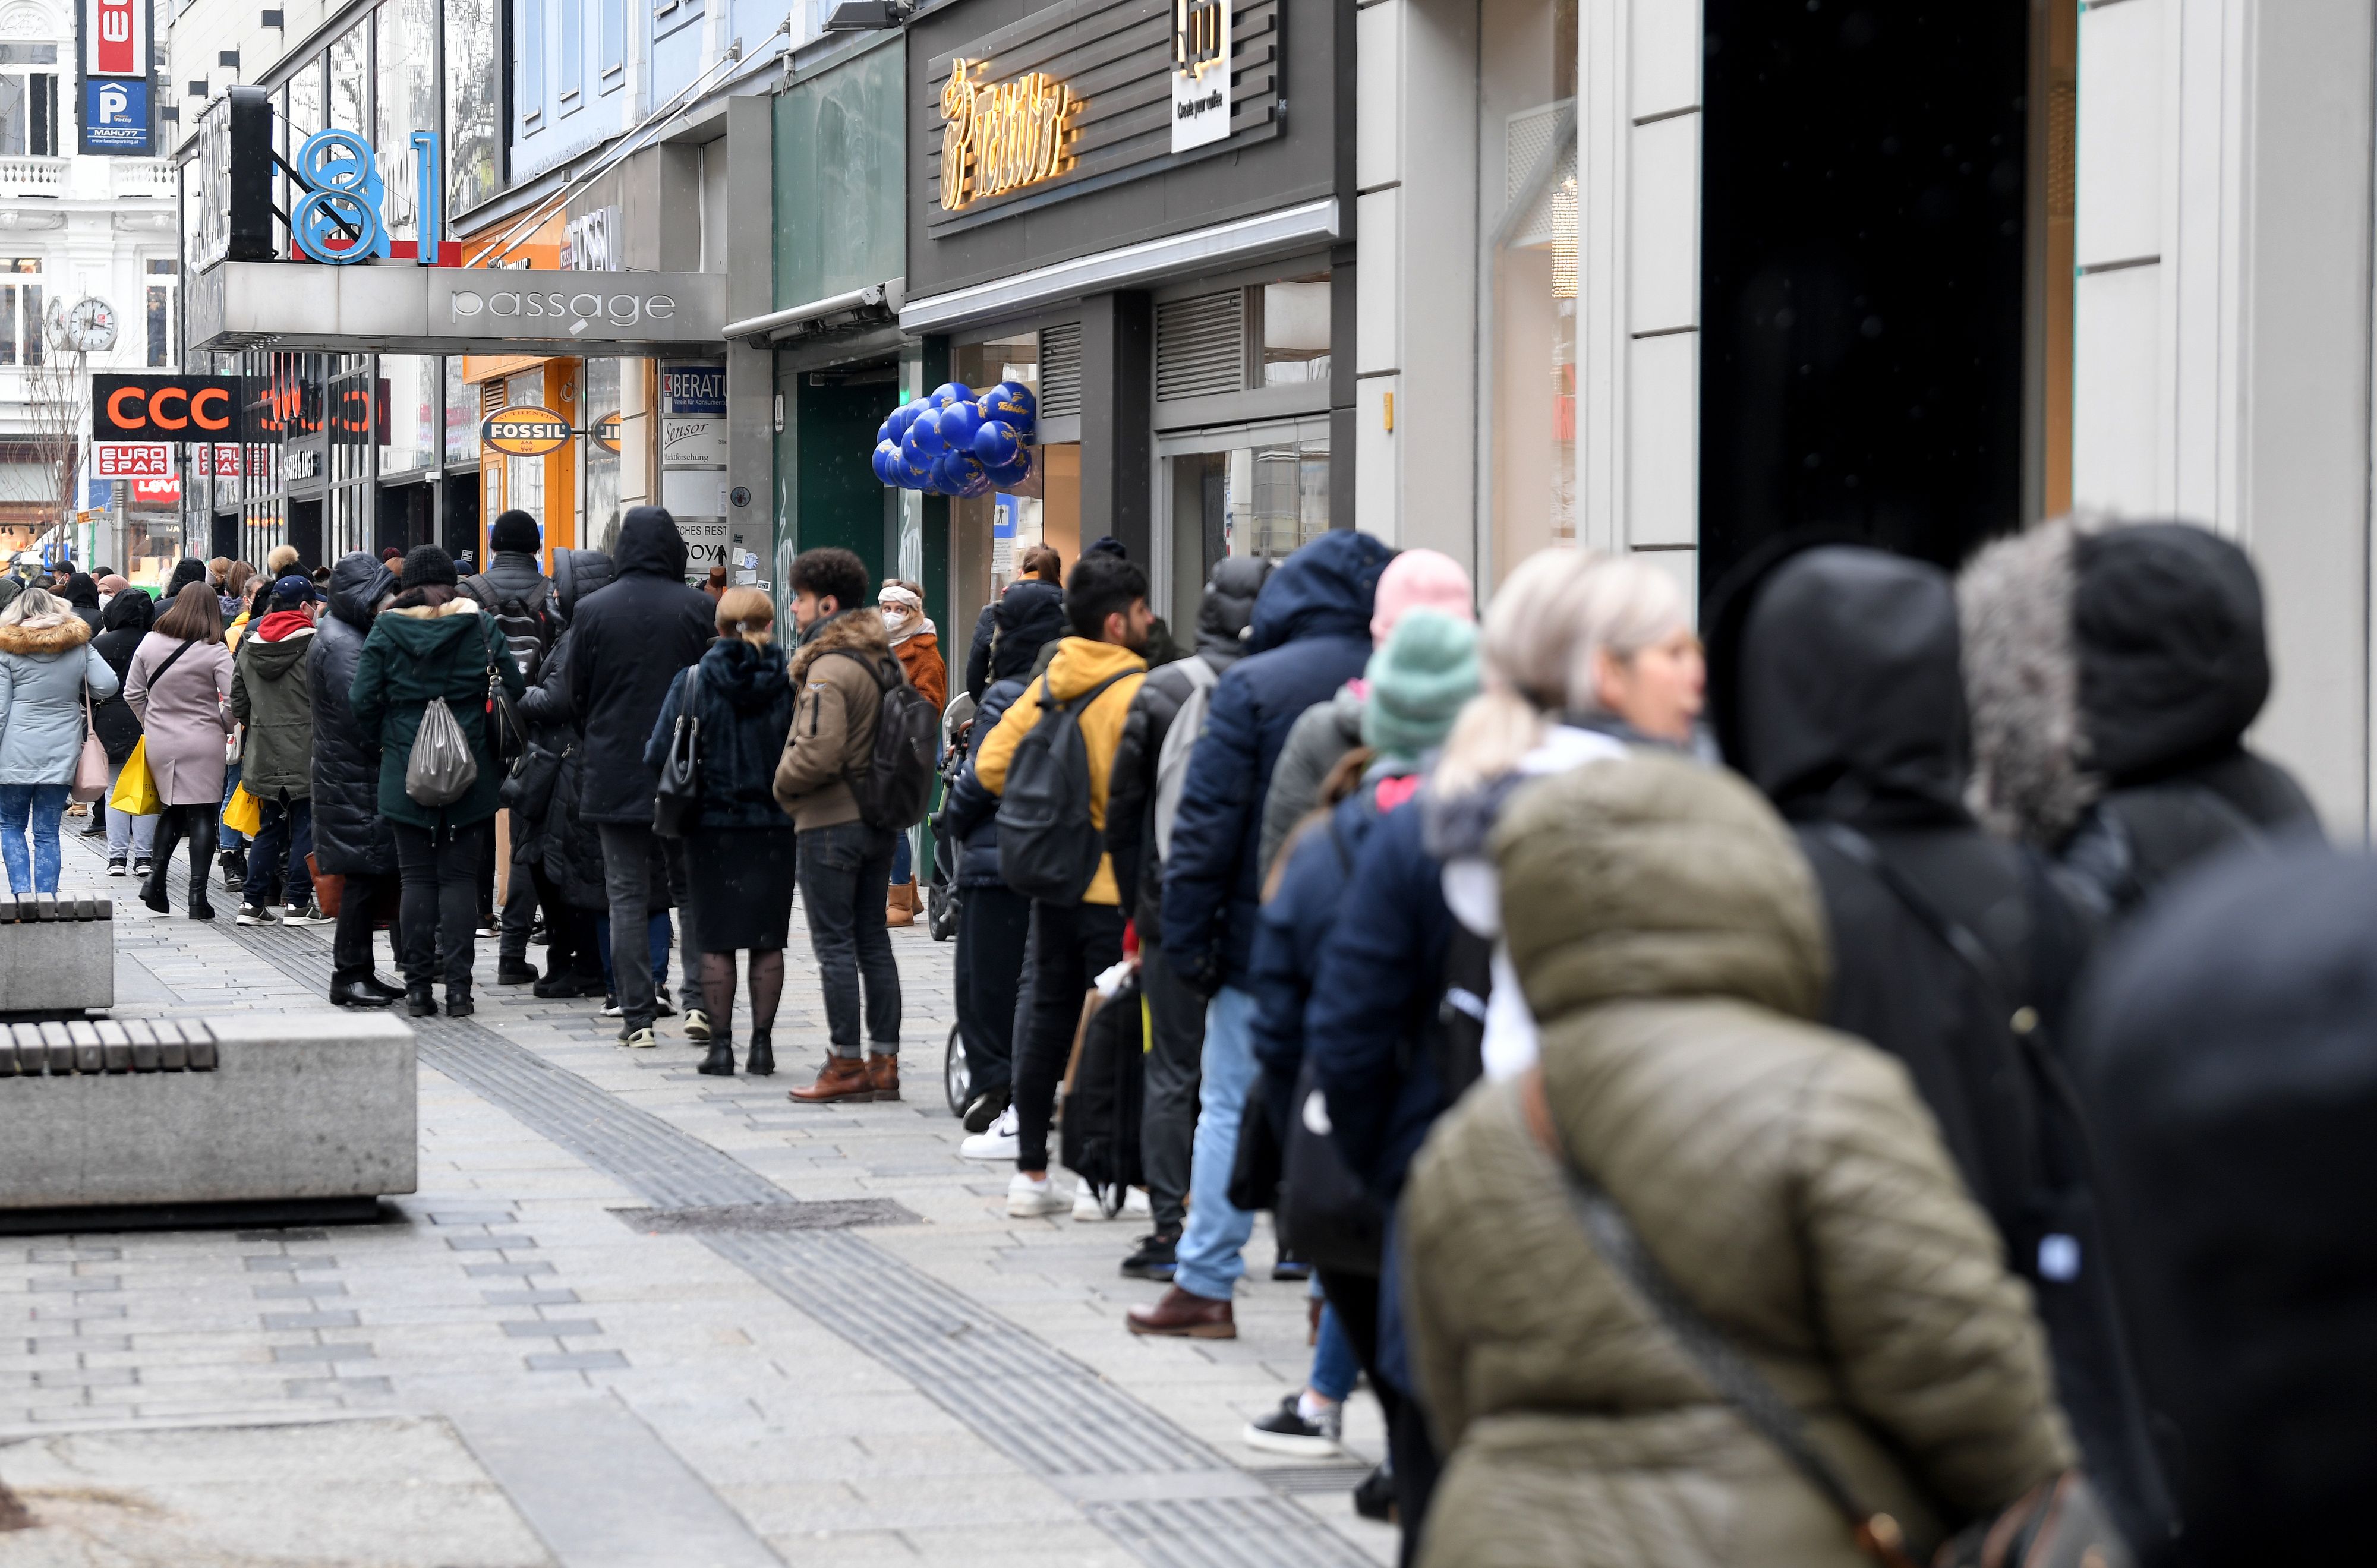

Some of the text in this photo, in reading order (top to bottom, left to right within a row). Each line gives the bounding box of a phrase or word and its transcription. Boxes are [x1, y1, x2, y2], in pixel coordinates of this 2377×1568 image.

[100, 92, 127, 124] P
[1177, 88, 1222, 119] Create your coffee
[570, 204, 621, 272] FOSSIL
[451, 290, 676, 326] passage
[107, 387, 229, 430] CCC
[997, 400, 1030, 415] Tchibo
[498, 411, 557, 422] AUTHENTIC
[491, 424, 566, 438] FOSSIL
[664, 422, 709, 444] Sensor
[102, 447, 165, 460] EURO
[664, 452, 709, 462] Marktforschung
[102, 460, 165, 473] SPAR
[705, 526, 727, 536] REST
